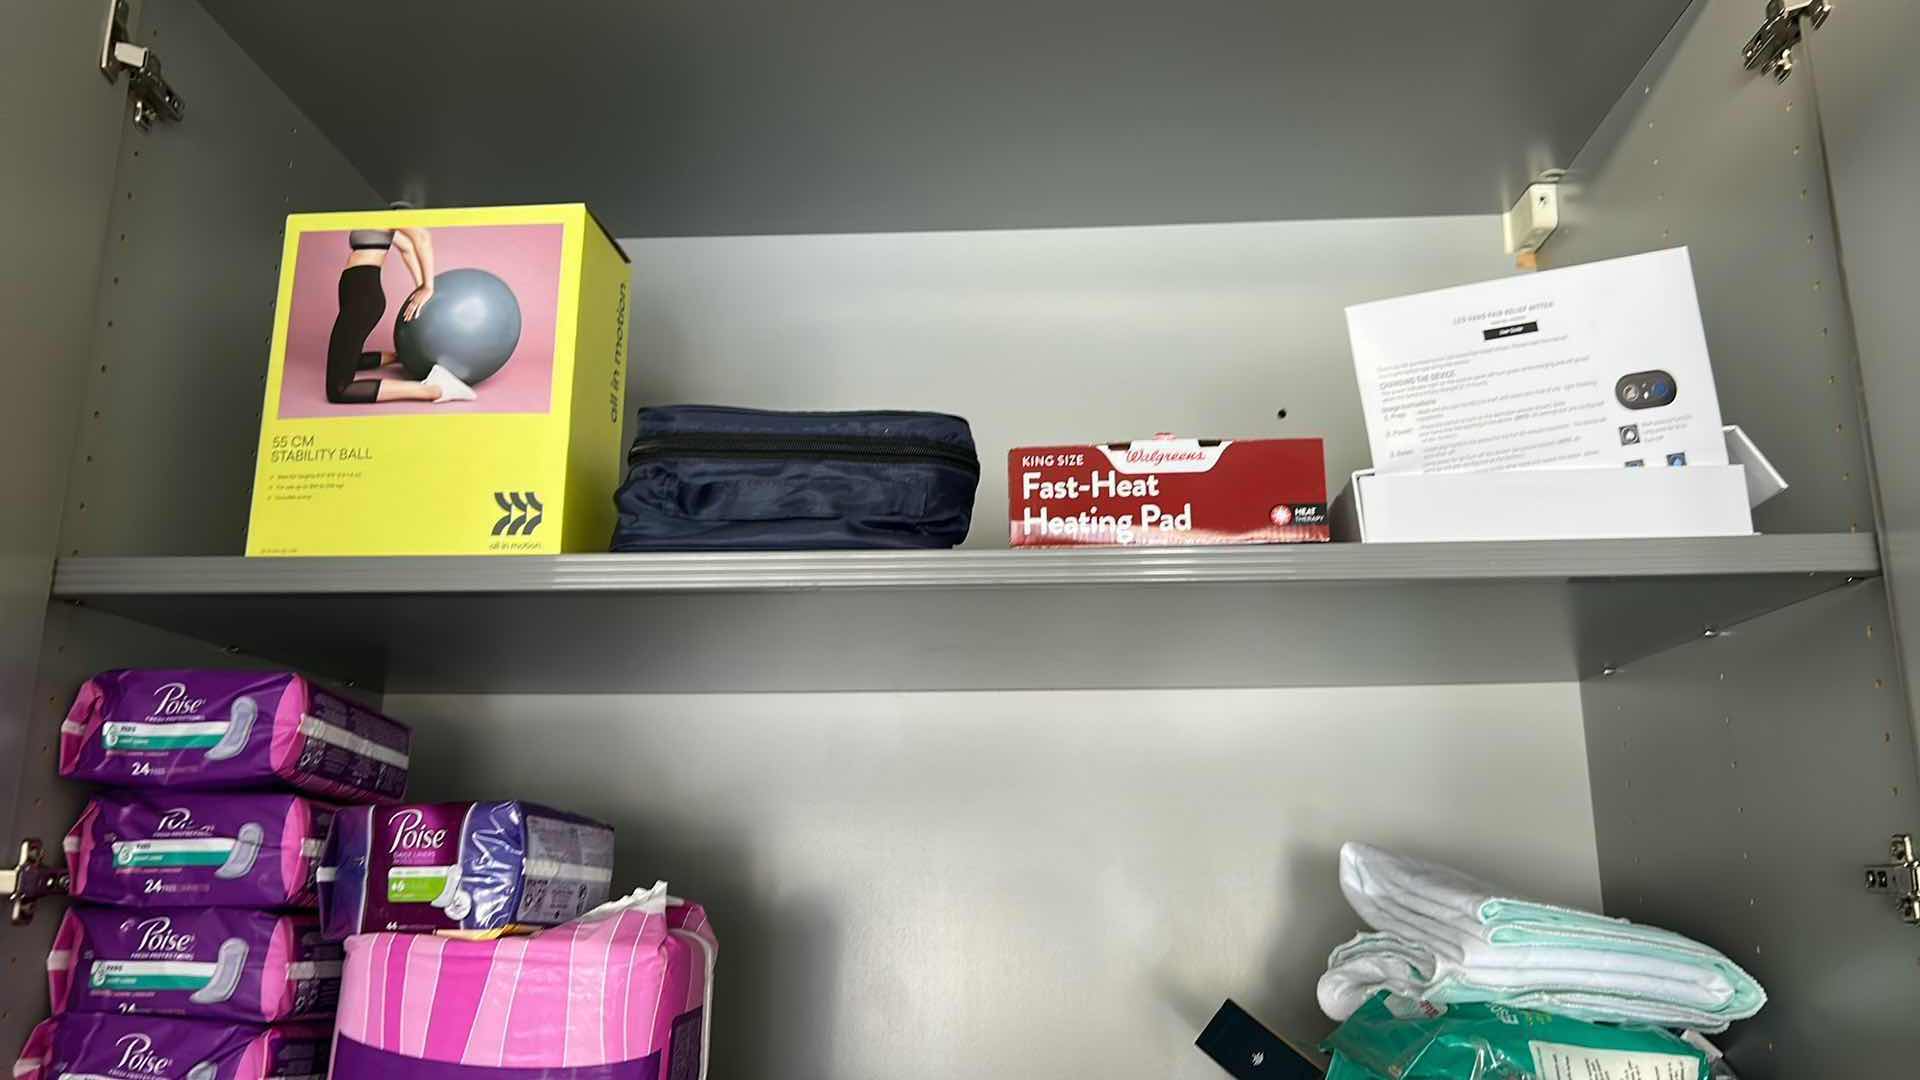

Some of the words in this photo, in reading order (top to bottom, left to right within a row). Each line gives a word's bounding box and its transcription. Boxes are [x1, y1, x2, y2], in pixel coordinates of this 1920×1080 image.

[614, 282, 627, 365] motion
[610, 370, 620, 392] in
[609, 392, 619, 423] all
[272, 435, 288, 448] 55
[291, 435, 315, 447] CM
[271, 448, 337, 463] STABILITY
[340, 447, 373, 460] BALL
[1022, 455, 1056, 467] KING
[1057, 454, 1085, 466] SIZE
[1126, 449, 1206, 465] Walgreens
[1022, 470, 1160, 500] Fast-Heat
[1023, 506, 1135, 543] Heating
[1140, 503, 1192, 532] Pad
[1294, 506, 1317, 516] HEAT
[153, 682, 203, 716] Poise
[130, 761, 150, 776] 24
[388, 808, 448, 854] Poise
[144, 879, 162, 893] 24
[137, 916, 191, 951] Poise
[115, 1033, 169, 1075] Poise
